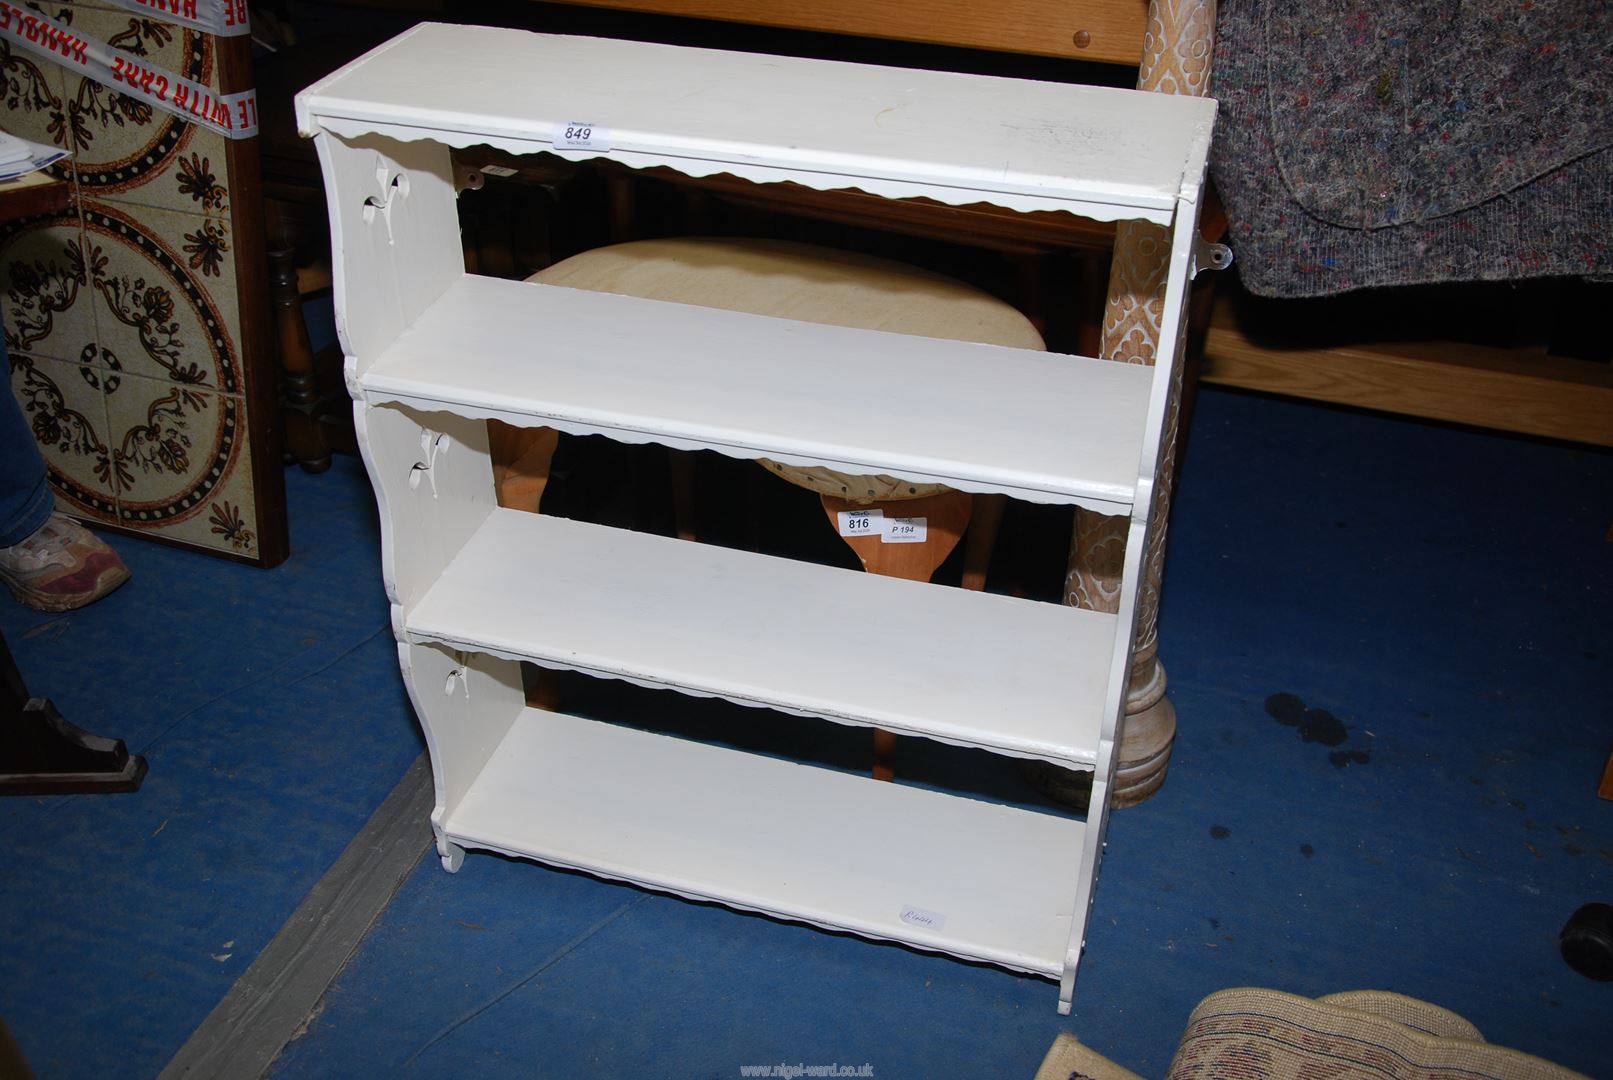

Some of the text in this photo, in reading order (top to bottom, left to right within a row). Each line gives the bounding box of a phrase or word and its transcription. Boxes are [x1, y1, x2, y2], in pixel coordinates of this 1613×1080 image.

[111, 56, 168, 102] CARE
[174, 83, 232, 130] WITH
[565, 127, 591, 140] 849
[848, 518, 869, 529] 816
[901, 525, 915, 533] 194
